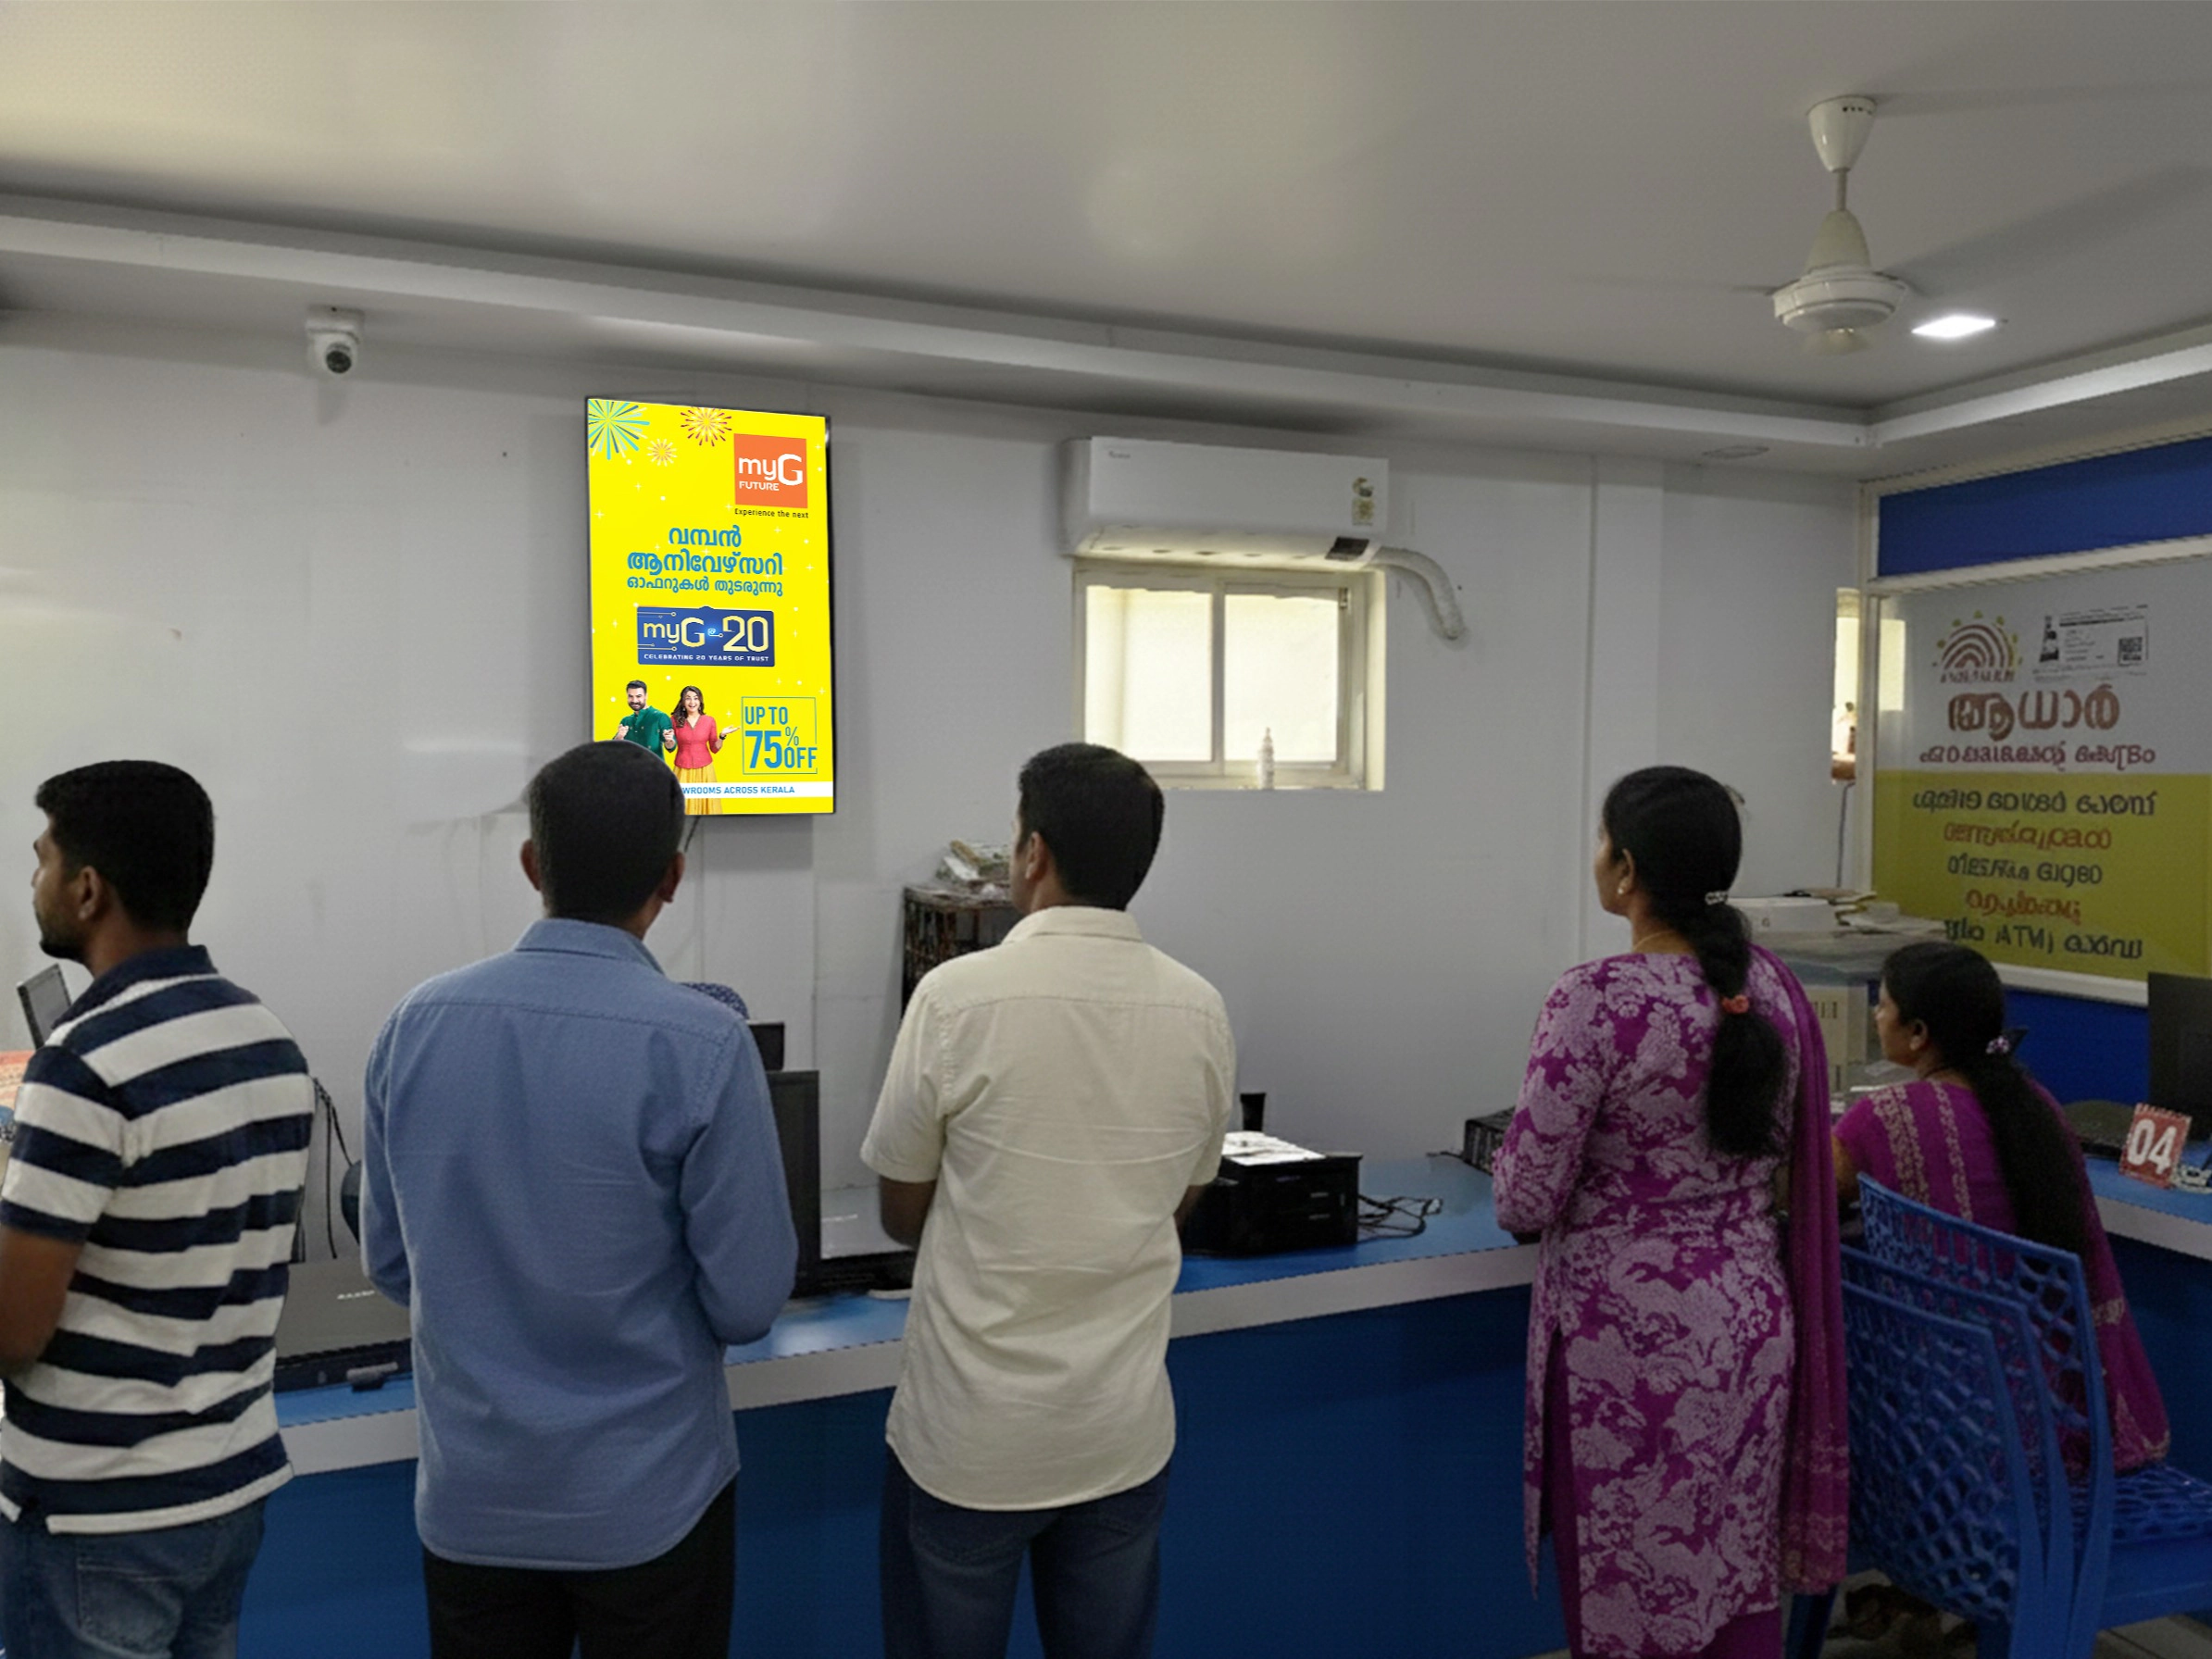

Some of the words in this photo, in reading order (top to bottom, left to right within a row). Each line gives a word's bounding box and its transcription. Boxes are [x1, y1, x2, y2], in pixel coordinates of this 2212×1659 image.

[738, 453, 804, 486] myG
[738, 480, 780, 492] FUTURE
[734, 508, 775, 518] Experience
[778, 509, 790, 518] the
[669, 524, 742, 548] വമ്പൻ
[627, 548, 783, 576] ആനിവേഴ്സറി
[627, 575, 709, 593] ഓഫറുകൾ
[714, 580, 783, 597] തുടരുന്നു
[722, 615, 769, 653] 20
[744, 705, 766, 725] UP
[768, 706, 788, 725] TO
[783, 746, 818, 768] OFF
[682, 786, 721, 794] WROOMS
[760, 785, 795, 793] KERALA
[2127, 1117, 2177, 1175] 04
